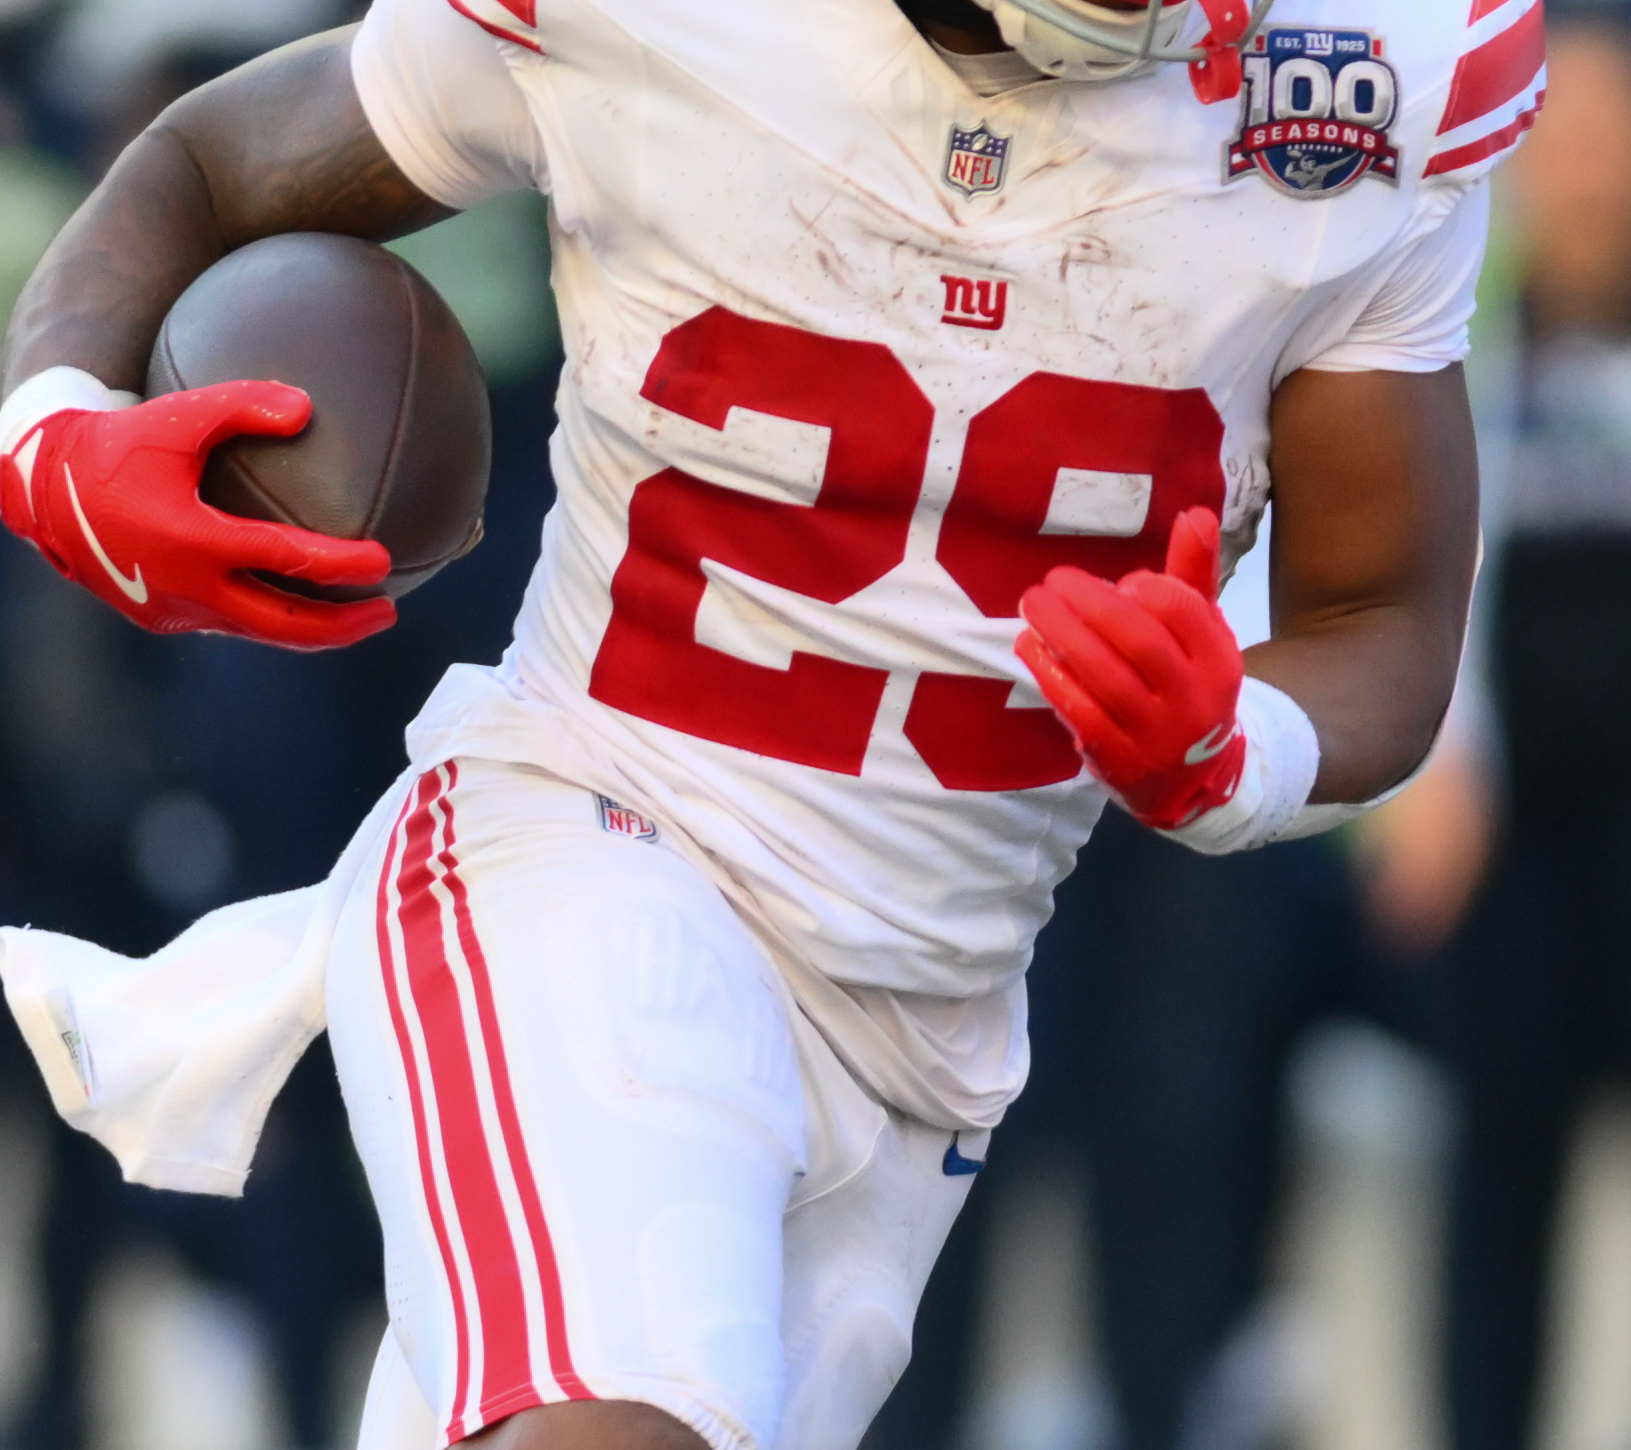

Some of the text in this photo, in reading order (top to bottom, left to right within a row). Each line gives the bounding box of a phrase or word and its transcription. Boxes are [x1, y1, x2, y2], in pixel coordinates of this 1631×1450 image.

[1275, 36, 1302, 49] EST.
[1336, 40, 1365, 52] 1925
[1243, 56, 1395, 130] 100
[1253, 122, 1376, 149] SEASONS
[952, 153, 996, 186] NFL
[589, 307, 1226, 793] 29
[608, 809, 652, 835] NFL
